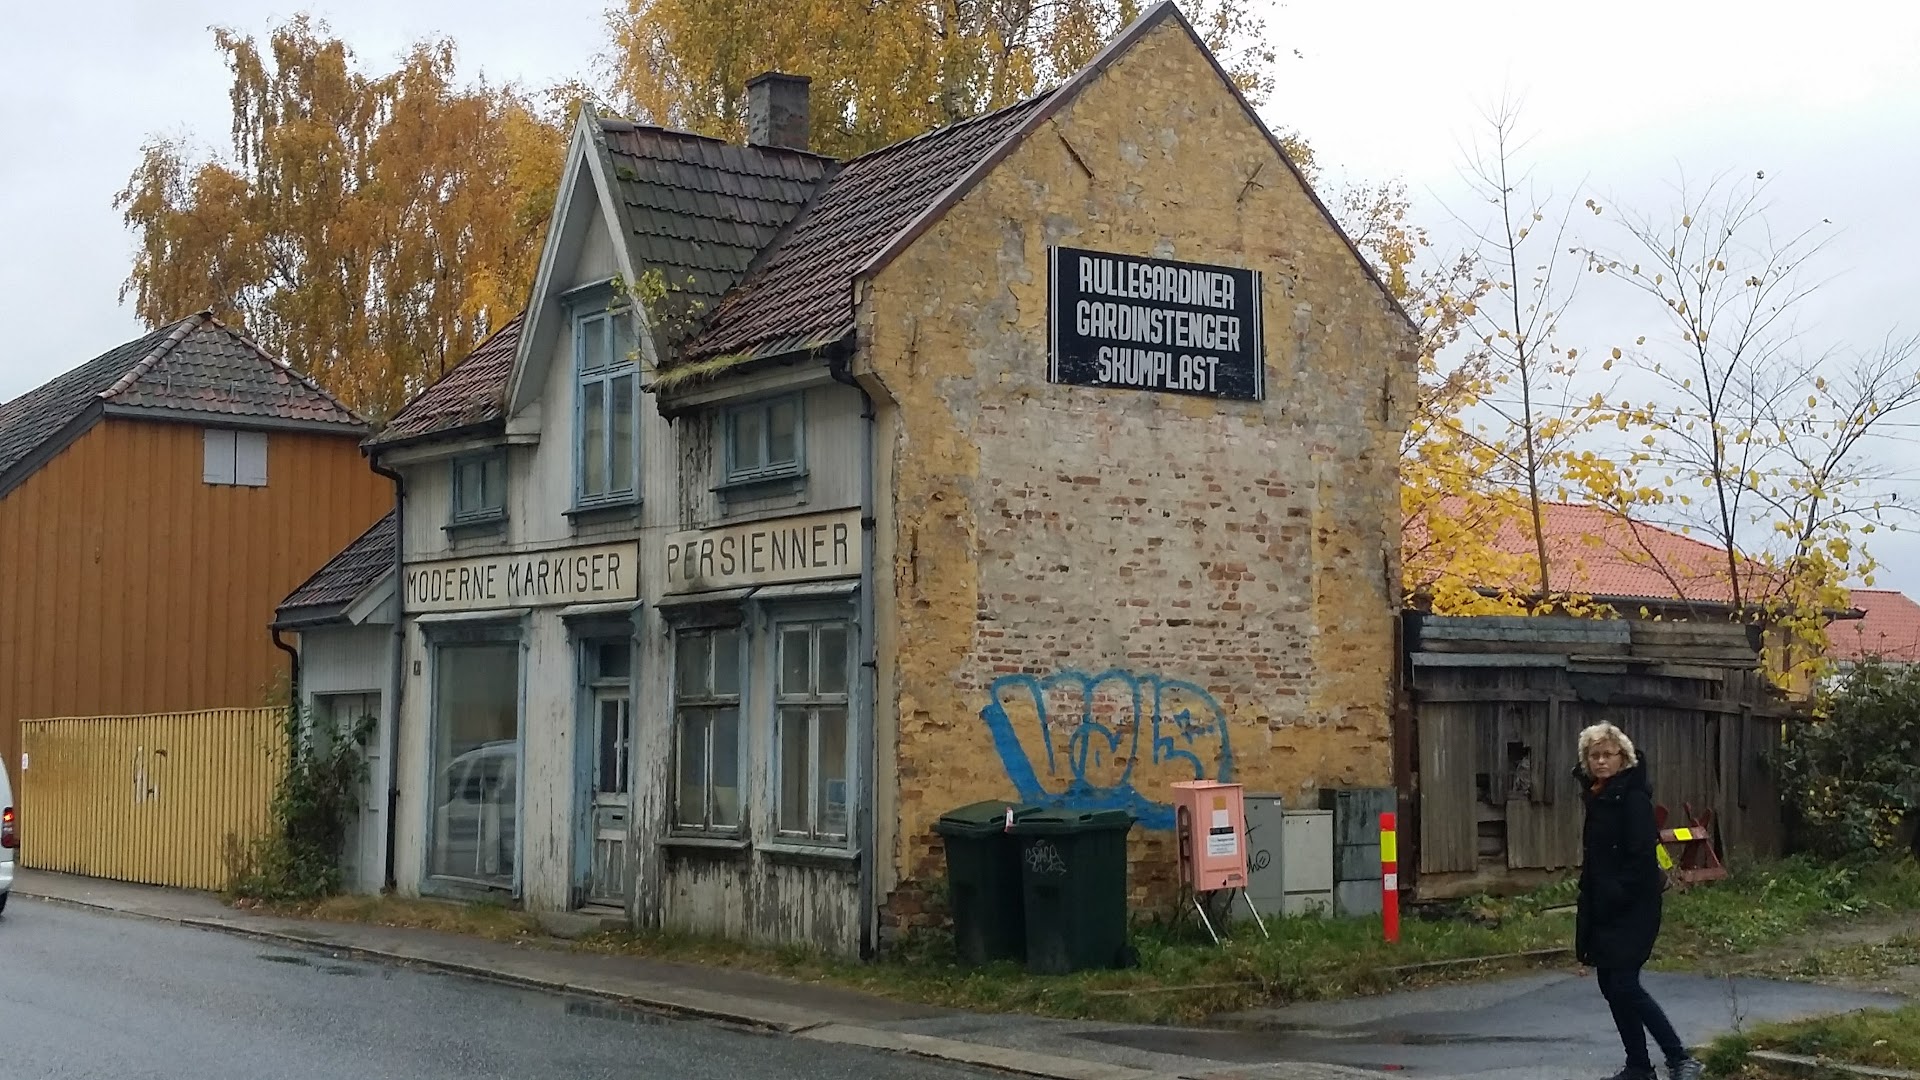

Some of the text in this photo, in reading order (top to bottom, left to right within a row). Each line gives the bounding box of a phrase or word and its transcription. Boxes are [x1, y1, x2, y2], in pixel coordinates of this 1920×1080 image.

[1079, 256, 1235, 310] RULLEGARDINER
[1076, 300, 1240, 352] GARDINSTENGER
[1098, 346, 1220, 392] SKUMPLAST
[406, 553, 621, 604] MODERNE MARKISER
[667, 523, 848, 583] PERSIENNER
